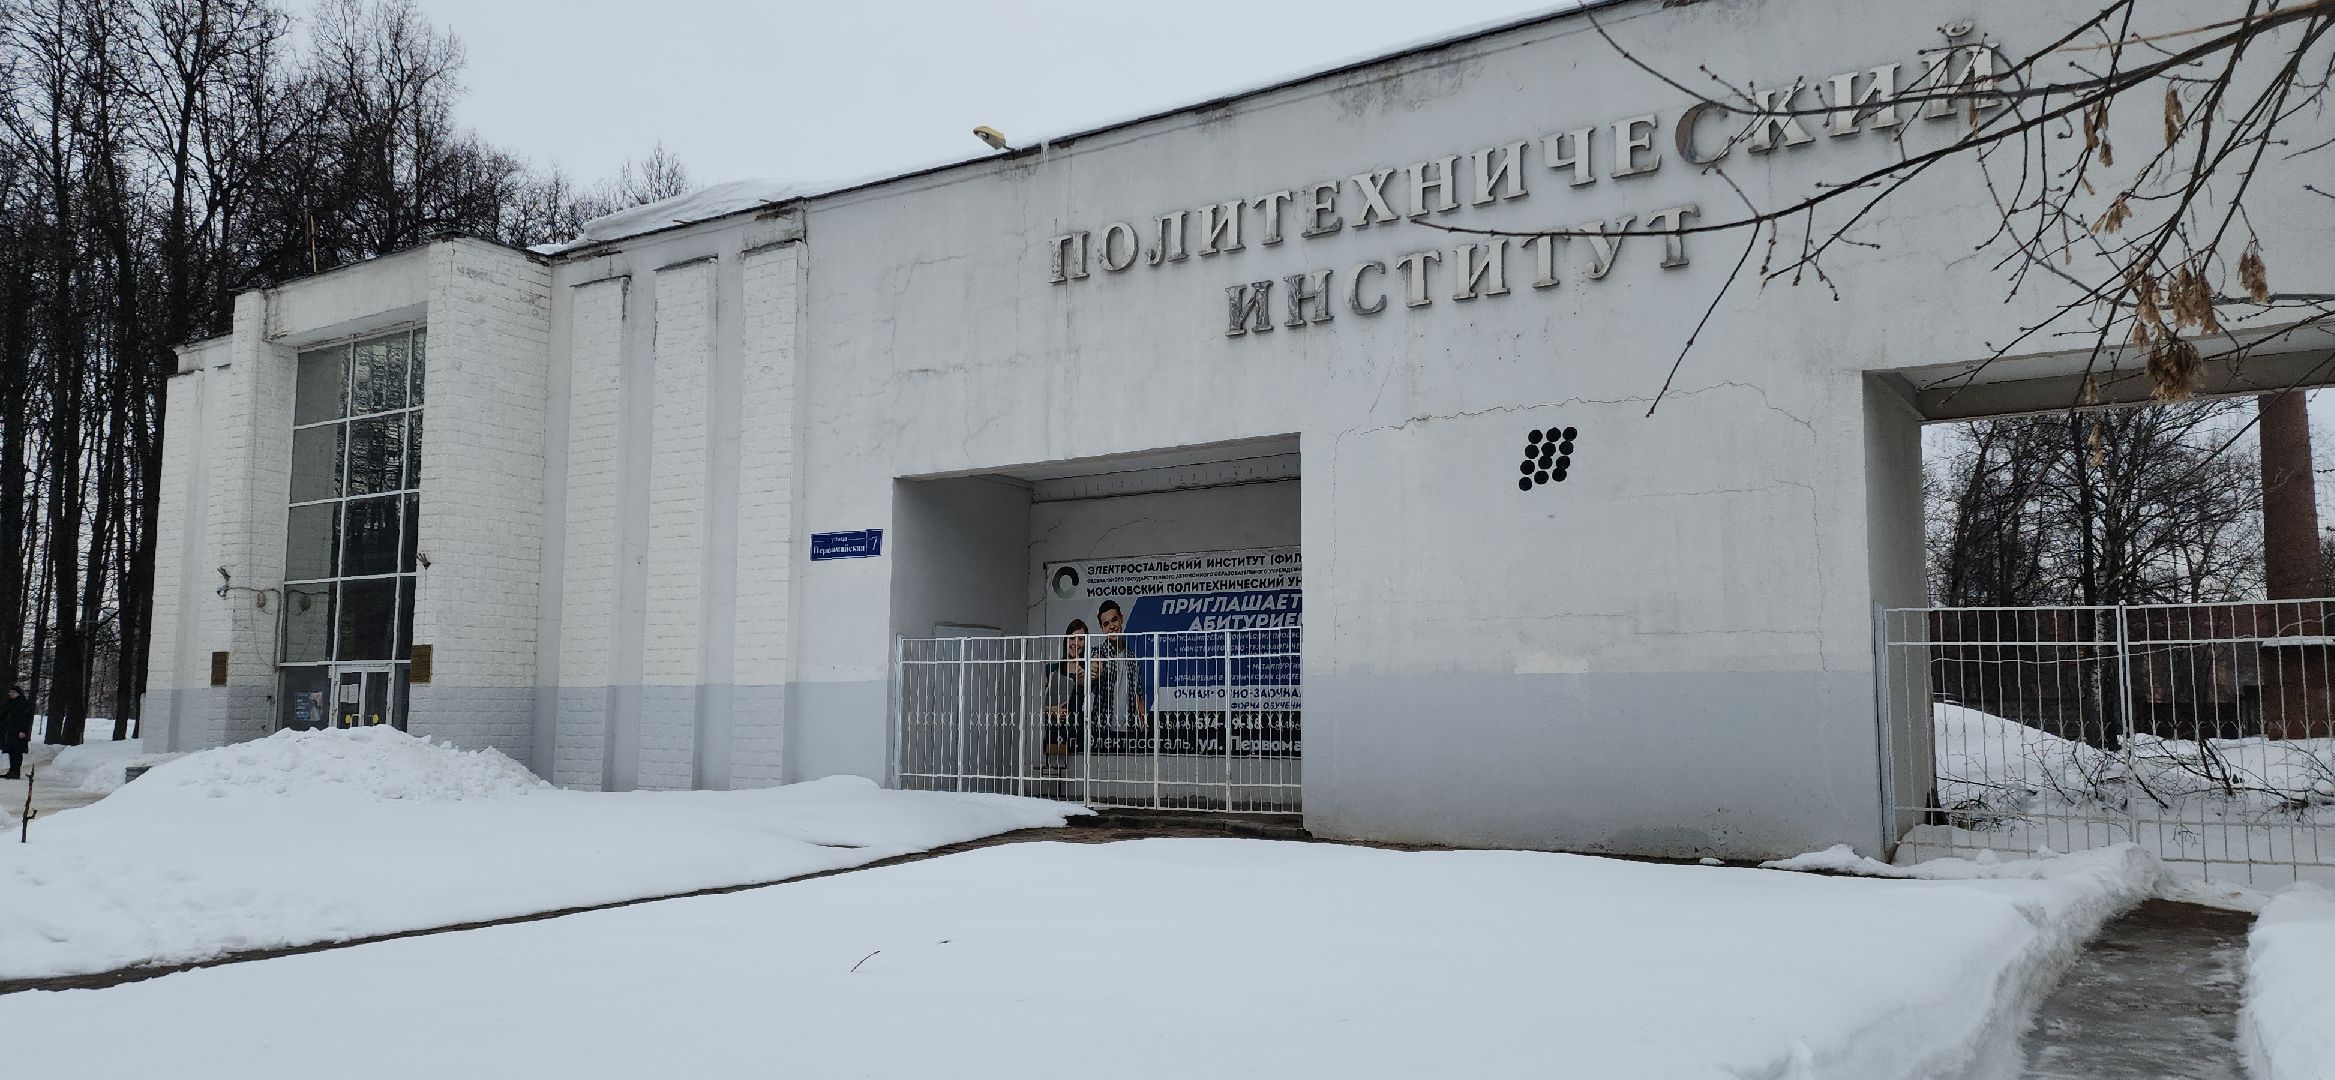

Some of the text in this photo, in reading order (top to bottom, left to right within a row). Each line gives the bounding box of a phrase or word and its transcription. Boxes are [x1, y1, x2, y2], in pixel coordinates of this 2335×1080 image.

[1048, 18, 2002, 284] ПОЛИТЕХНИЧЕСКИЙ
[1225, 203, 1701, 337] ИНСТИТУТ
[871, 536, 878, 551] 7
[1087, 557, 1202, 575] ЭЛЕКТРОСТАЛЬСКИЙ
[1207, 555, 1265, 568] ИНСТИТУТ
[1087, 580, 1164, 597] МОСКОВСКИЙ
[1167, 574, 1284, 593] ПОЛИТЕХНИЧЕСКИЙ
[1161, 593, 1302, 615] ПРИГЛАШАЕТ
